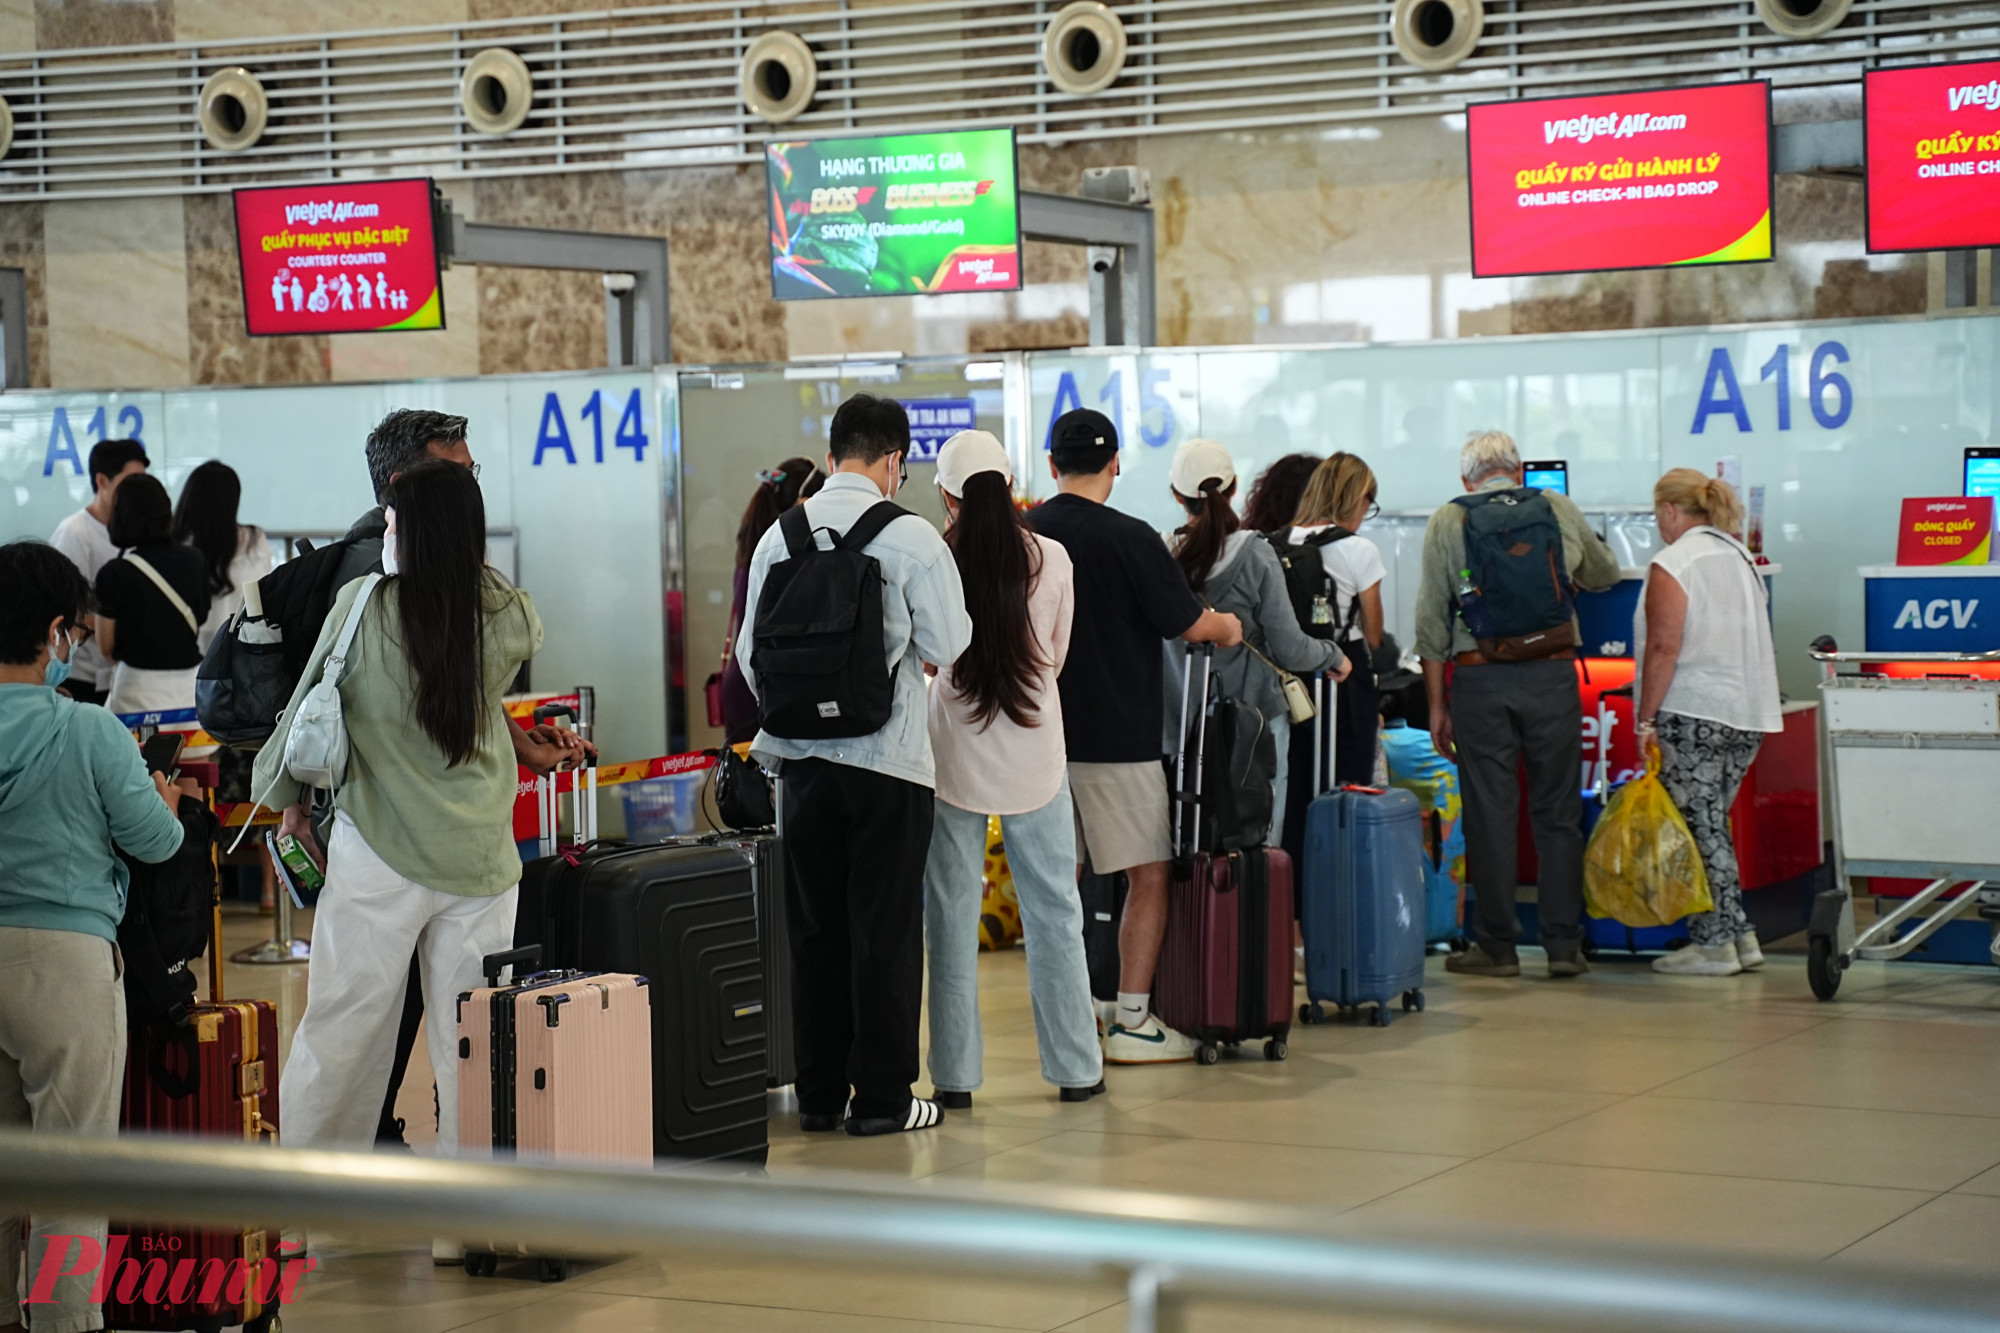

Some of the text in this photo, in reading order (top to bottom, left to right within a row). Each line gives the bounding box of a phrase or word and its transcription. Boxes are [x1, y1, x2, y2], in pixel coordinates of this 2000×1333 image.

[820, 157, 865, 180] HẠNG
[938, 152, 966, 170] GIA
[1571, 162, 1597, 182] KÝ
[1599, 157, 1632, 181] GỬI
[1636, 156, 1692, 177] HÀNH
[1696, 152, 1721, 173] LÝ
[1918, 161, 1975, 178] ONLINE
[1518, 180, 1718, 207] ONLINE CHECK-IN BAG DROP
[298, 234, 331, 251] PHỤC
[333, 232, 351, 249] VỤ
[353, 227, 378, 247] ĐẶC
[381, 226, 409, 246] BIỆT
[288, 252, 386, 268] COURTESY COUNTER
[1690, 340, 1854, 434] A16
[1044, 368, 1175, 450] A15
[532, 387, 648, 466] A14
[1924, 536, 1962, 546] CLOSED
[1893, 599, 1979, 629] ACV
[143, 713, 162, 725] ACV
